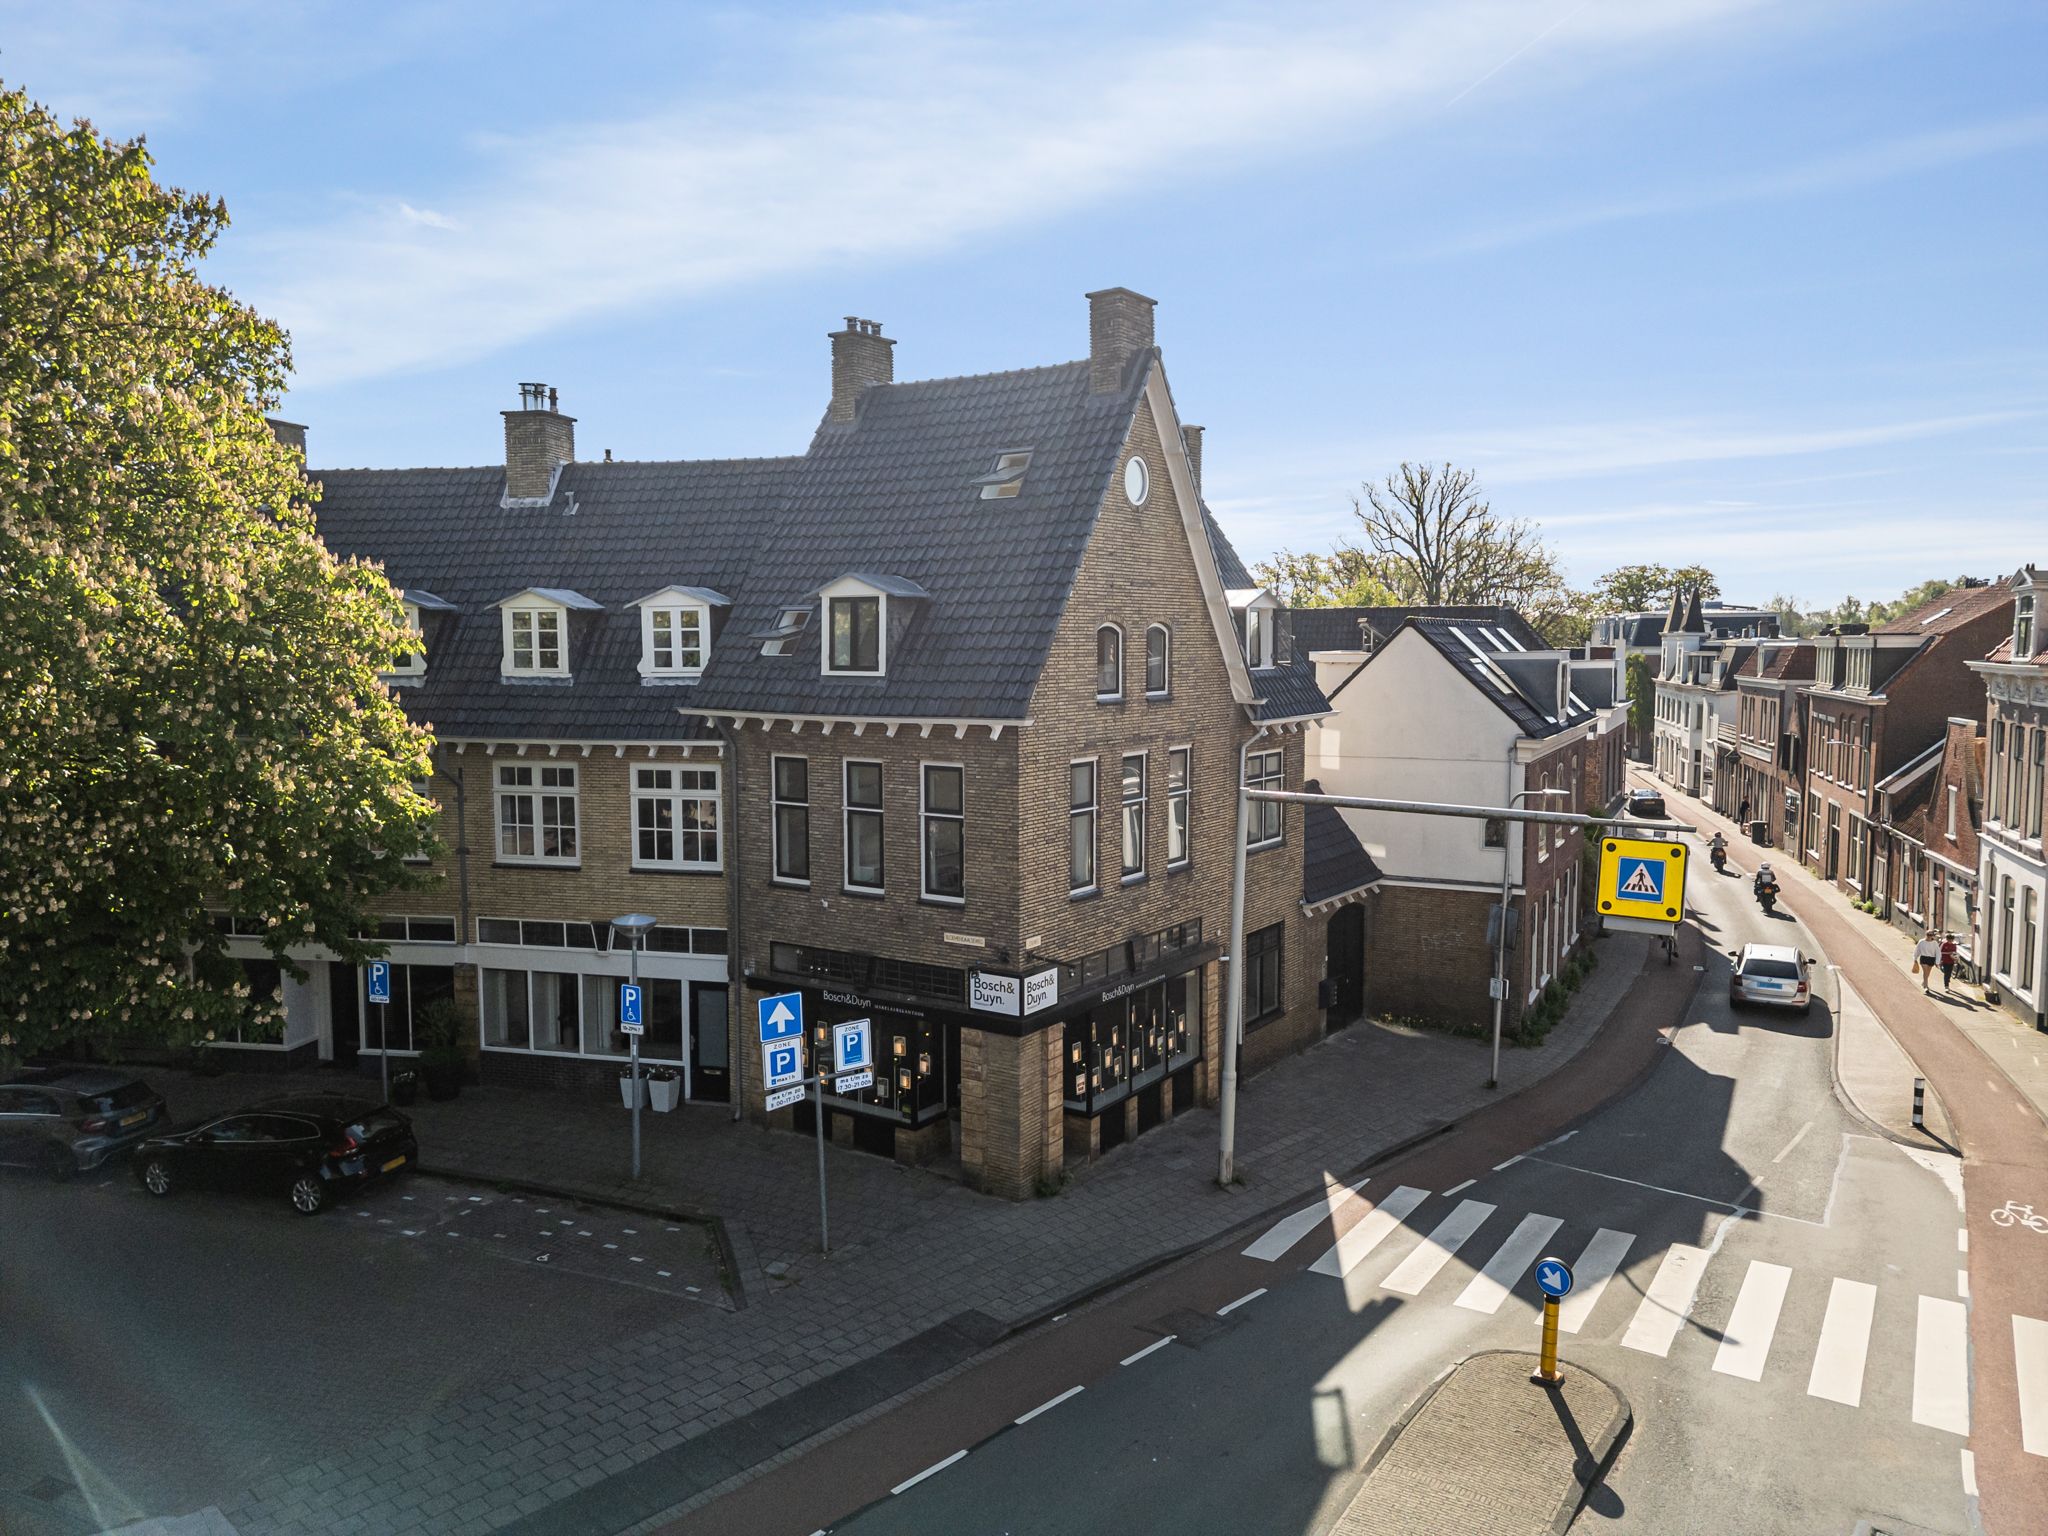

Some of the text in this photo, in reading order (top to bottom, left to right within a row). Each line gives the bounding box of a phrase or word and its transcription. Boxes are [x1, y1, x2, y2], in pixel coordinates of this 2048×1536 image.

[373, 964, 384, 981] P
[974, 978, 1015, 995] Bosch&
[1026, 974, 1055, 993] Bosch&
[626, 989, 636, 1006] P
[823, 990, 872, 1009] Bosch&Duyn
[974, 989, 1005, 1006] Duyn.
[1102, 983, 1135, 1002] Bosch&Duyn
[773, 1041, 792, 1049] ZONE
[846, 1034, 858, 1052] P
[776, 1052, 790, 1073] P
